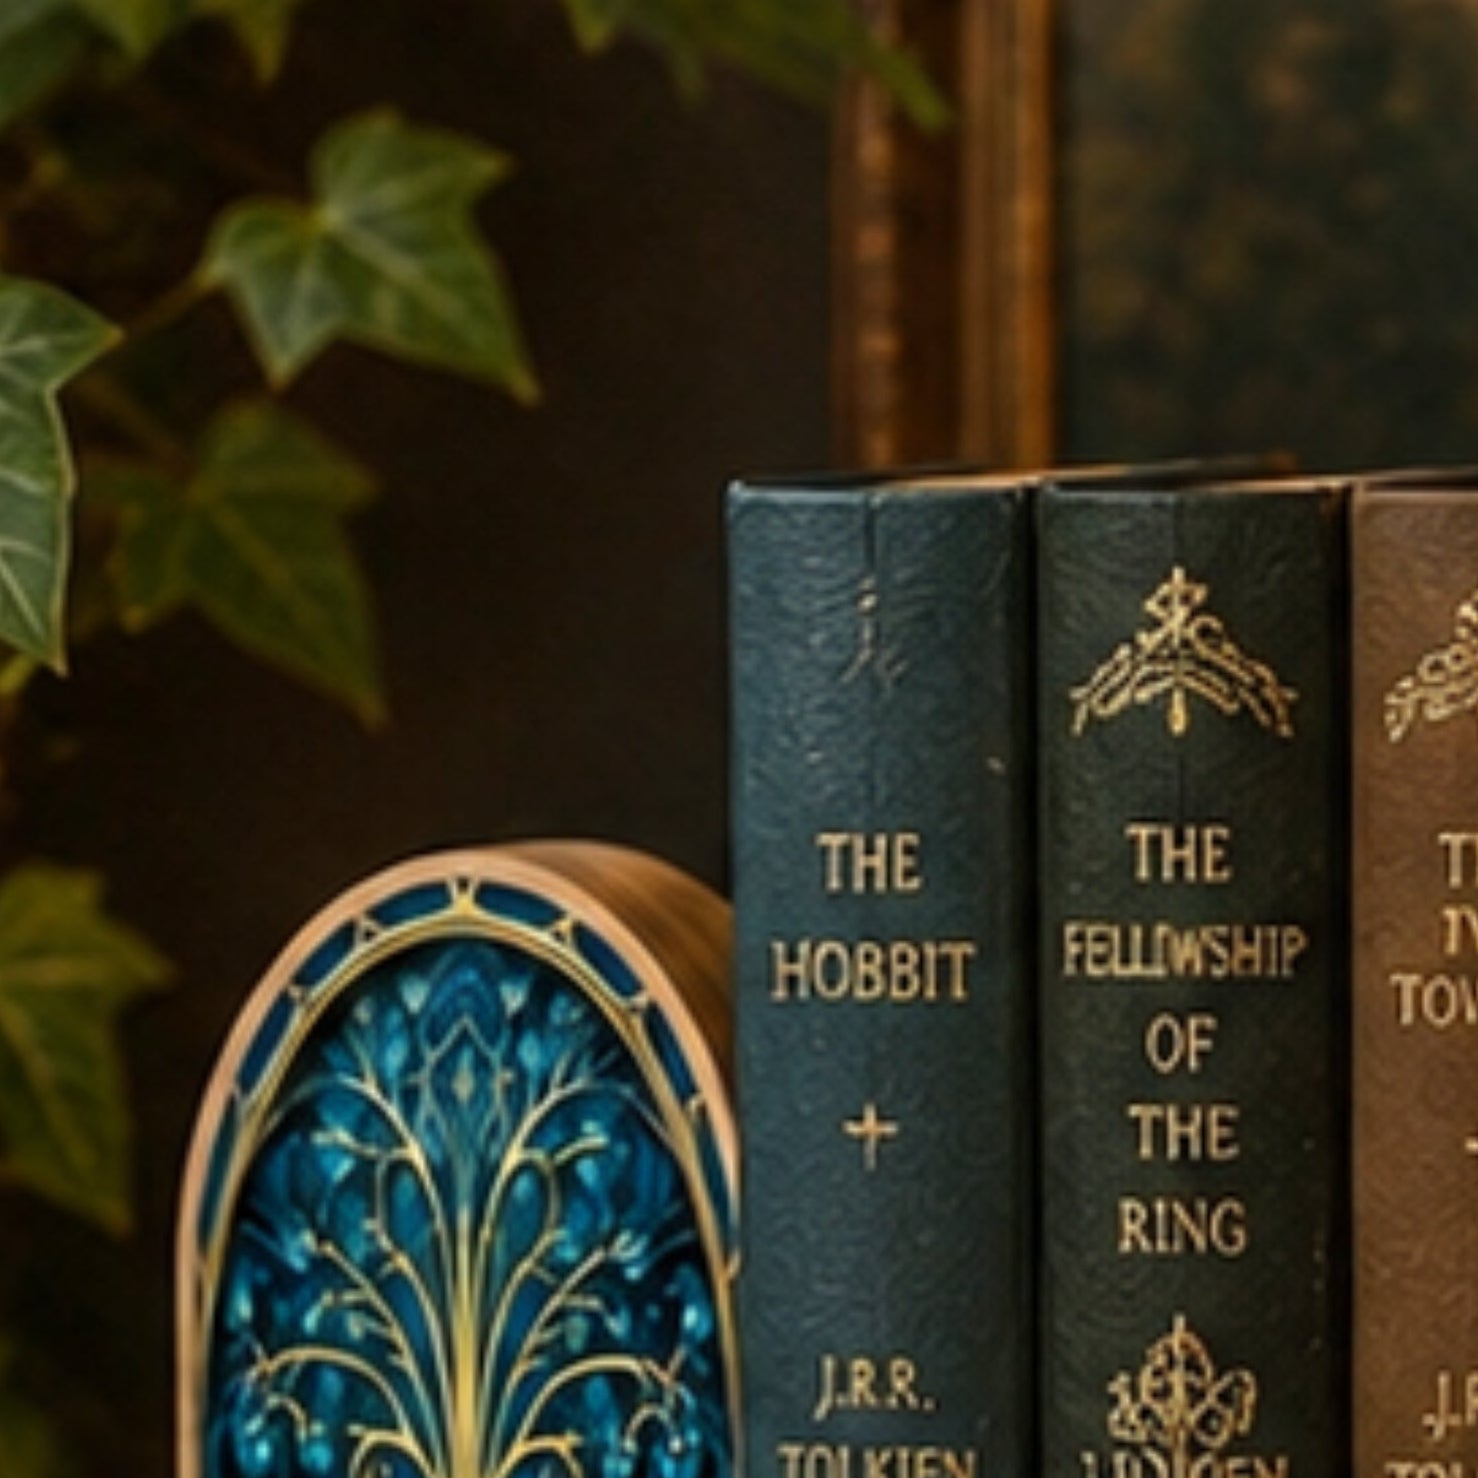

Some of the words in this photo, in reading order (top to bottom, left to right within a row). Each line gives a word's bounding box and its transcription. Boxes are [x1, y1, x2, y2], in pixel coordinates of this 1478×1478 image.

[817, 833, 921, 892] THE
[1126, 824, 1231, 882] THE
[772, 940, 976, 1001] HOBBIT
[1146, 1013, 1217, 1073] OF
[1128, 1104, 1239, 1159] THE
[1119, 1199, 1246, 1255] RING
